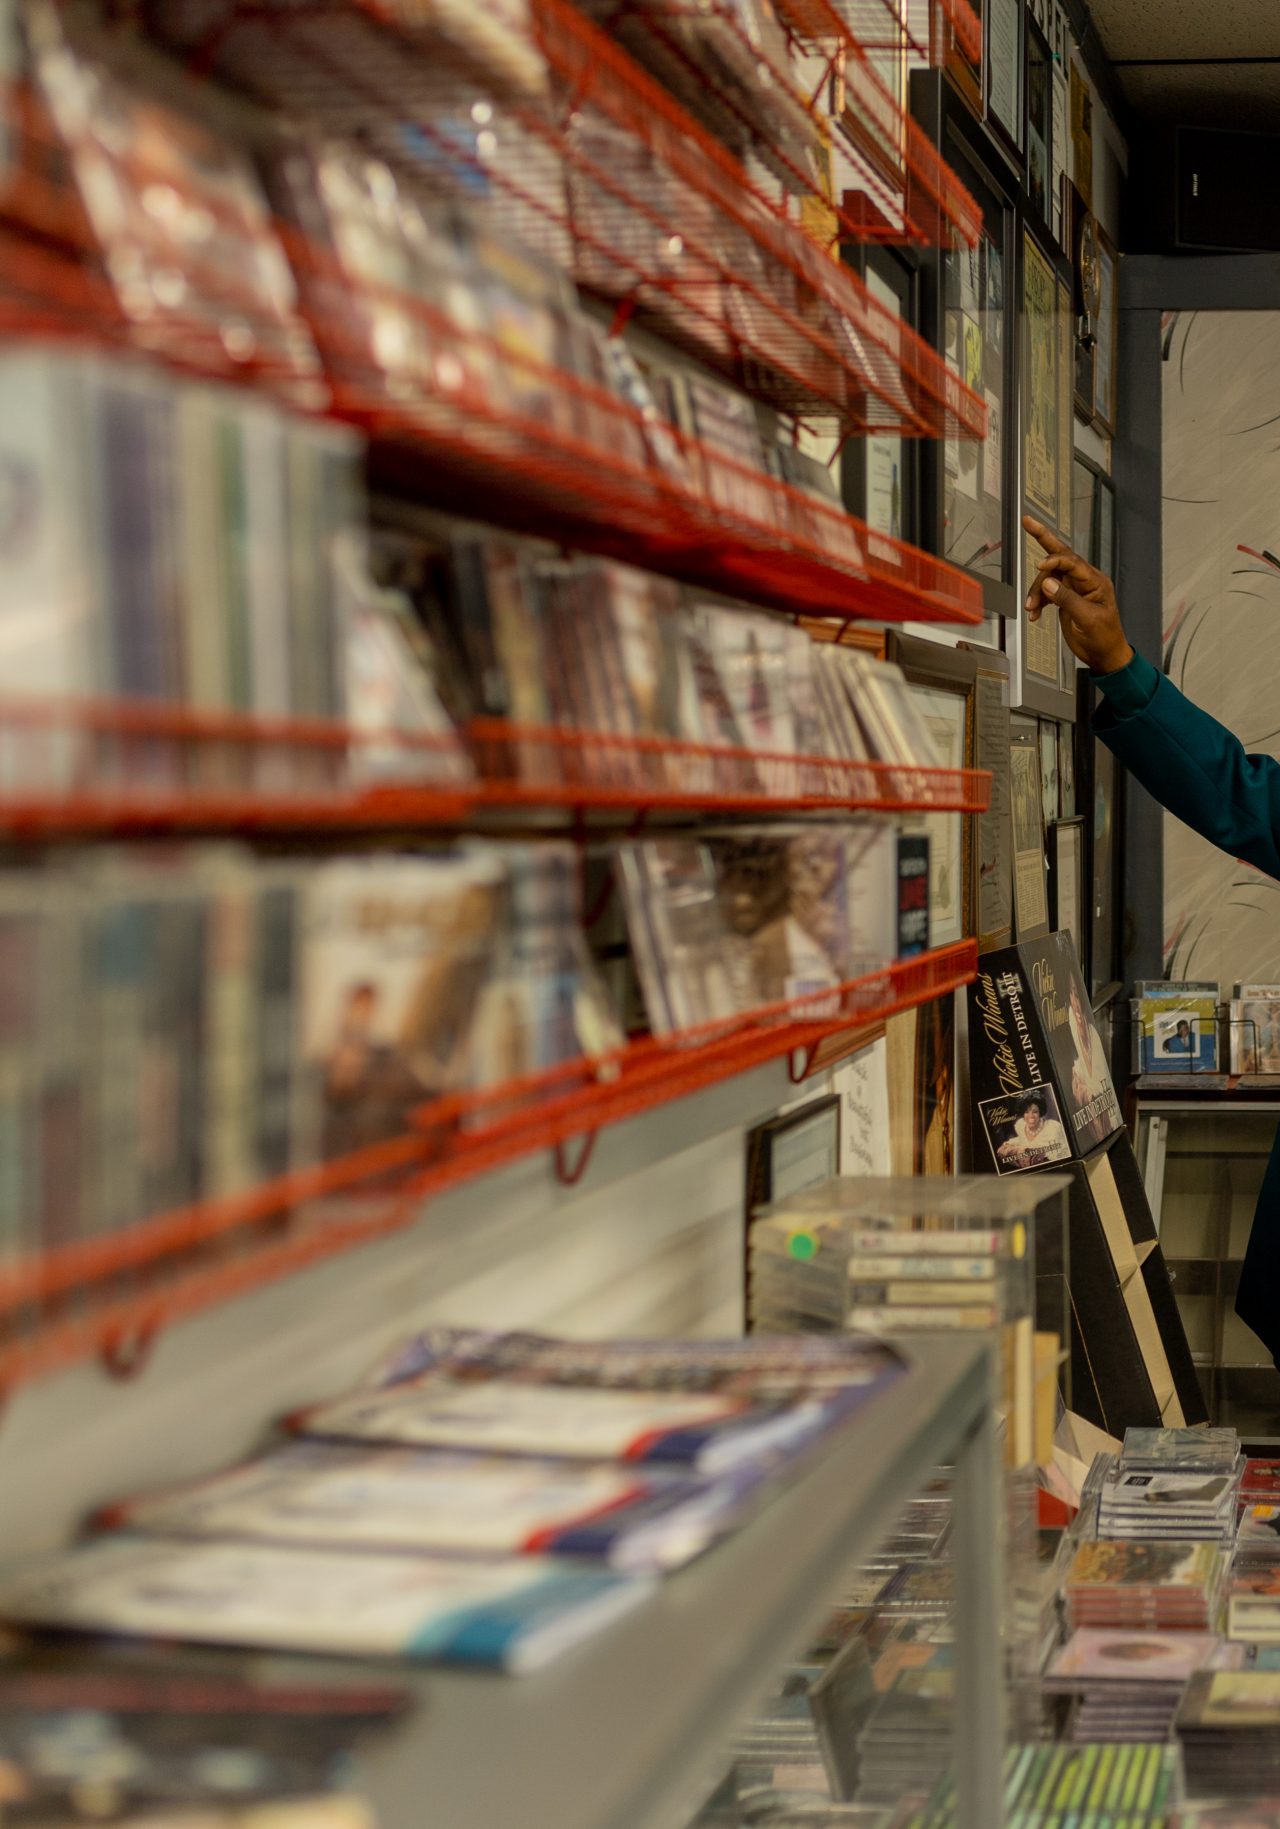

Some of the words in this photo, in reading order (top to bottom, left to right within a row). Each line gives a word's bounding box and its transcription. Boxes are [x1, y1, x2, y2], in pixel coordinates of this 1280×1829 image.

[1002, 972, 1030, 1030] DETROIT
[1021, 1031, 1033, 1052] IN
[1025, 1053, 1042, 1084] LIVE
